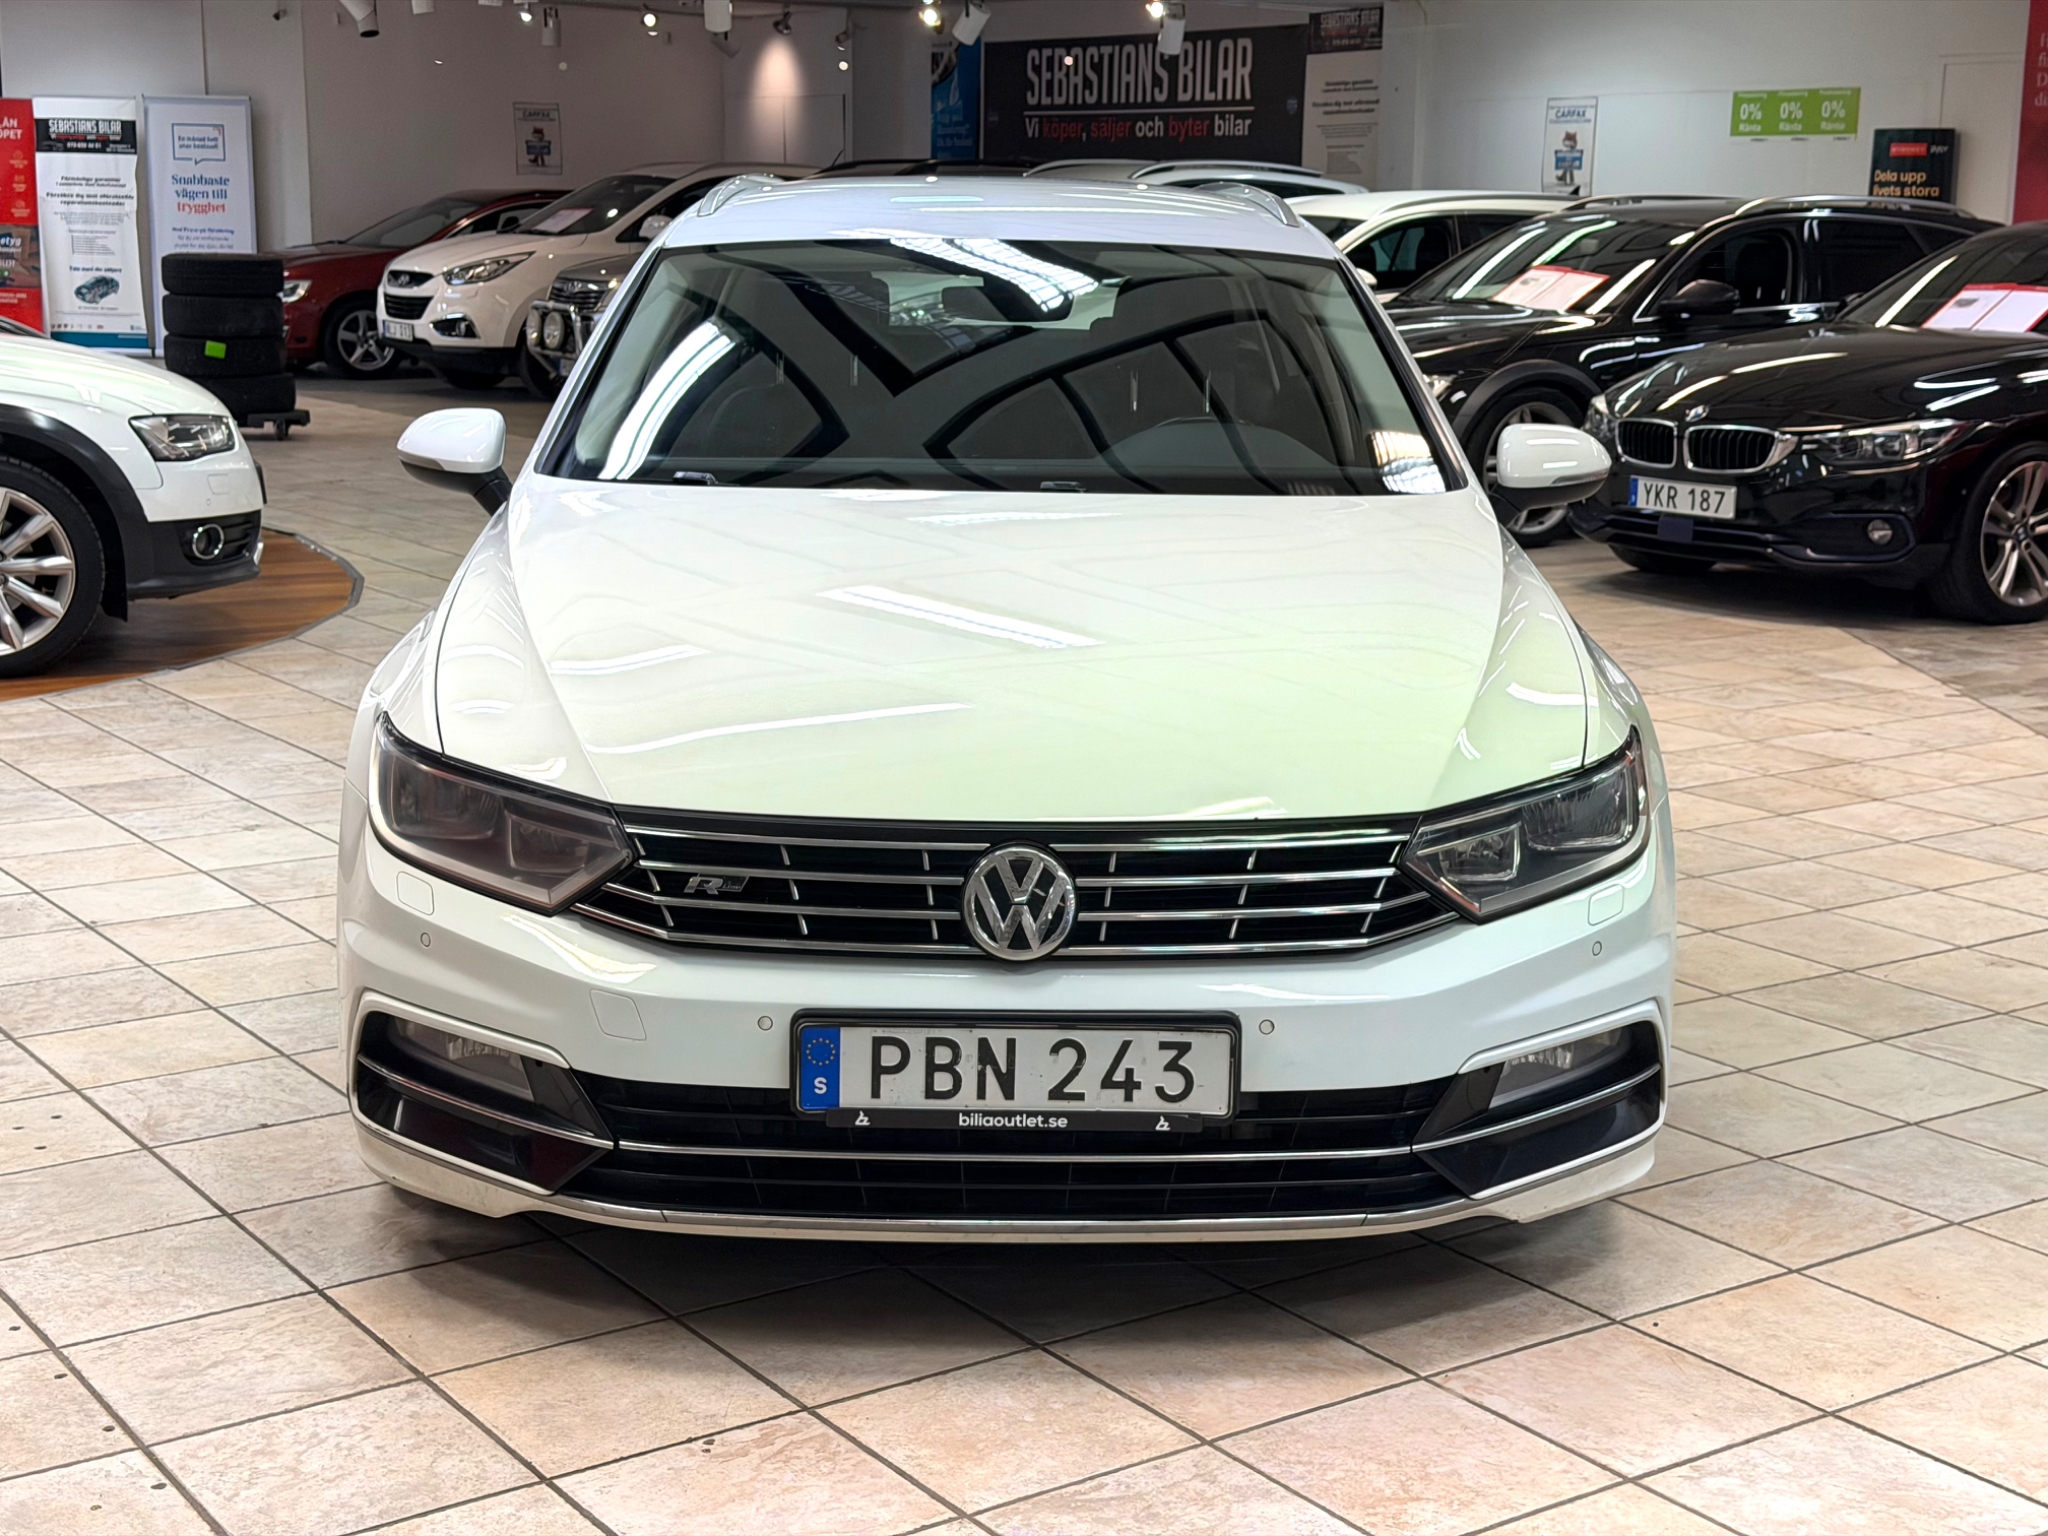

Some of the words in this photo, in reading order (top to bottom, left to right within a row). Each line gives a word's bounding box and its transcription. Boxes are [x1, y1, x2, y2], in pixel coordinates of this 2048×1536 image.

[1026, 43, 1169, 105] SEBASTIANS
[1177, 38, 1253, 102] BILAR
[1740, 103, 1762, 120] 0%
[1780, 102, 1803, 119] 0%
[1821, 101, 1846, 118] 0%
[1025, 118, 1039, 138] Vi
[1042, 119, 1087, 141] köper,
[1090, 117, 1132, 142] säljer
[1135, 116, 1164, 137] och
[1168, 115, 1210, 142] byter
[1214, 114, 1252, 137] bilar
[171, 174, 230, 186] Snabbaste
[1875, 169, 1898, 182] Dela
[1900, 171, 1927, 184] upp
[175, 188, 209, 200] vägen
[212, 189, 228, 200] till
[1903, 185, 1940, 197] stora
[177, 202, 226, 214] trygghet
[1644, 483, 1677, 509] YKR
[1688, 488, 1726, 514] 187
[871, 1035, 1017, 1101] PBN
[1048, 1038, 1195, 1103] 243
[813, 1077, 828, 1094] S
[958, 1113, 1068, 1129] biliaoutlet.se
